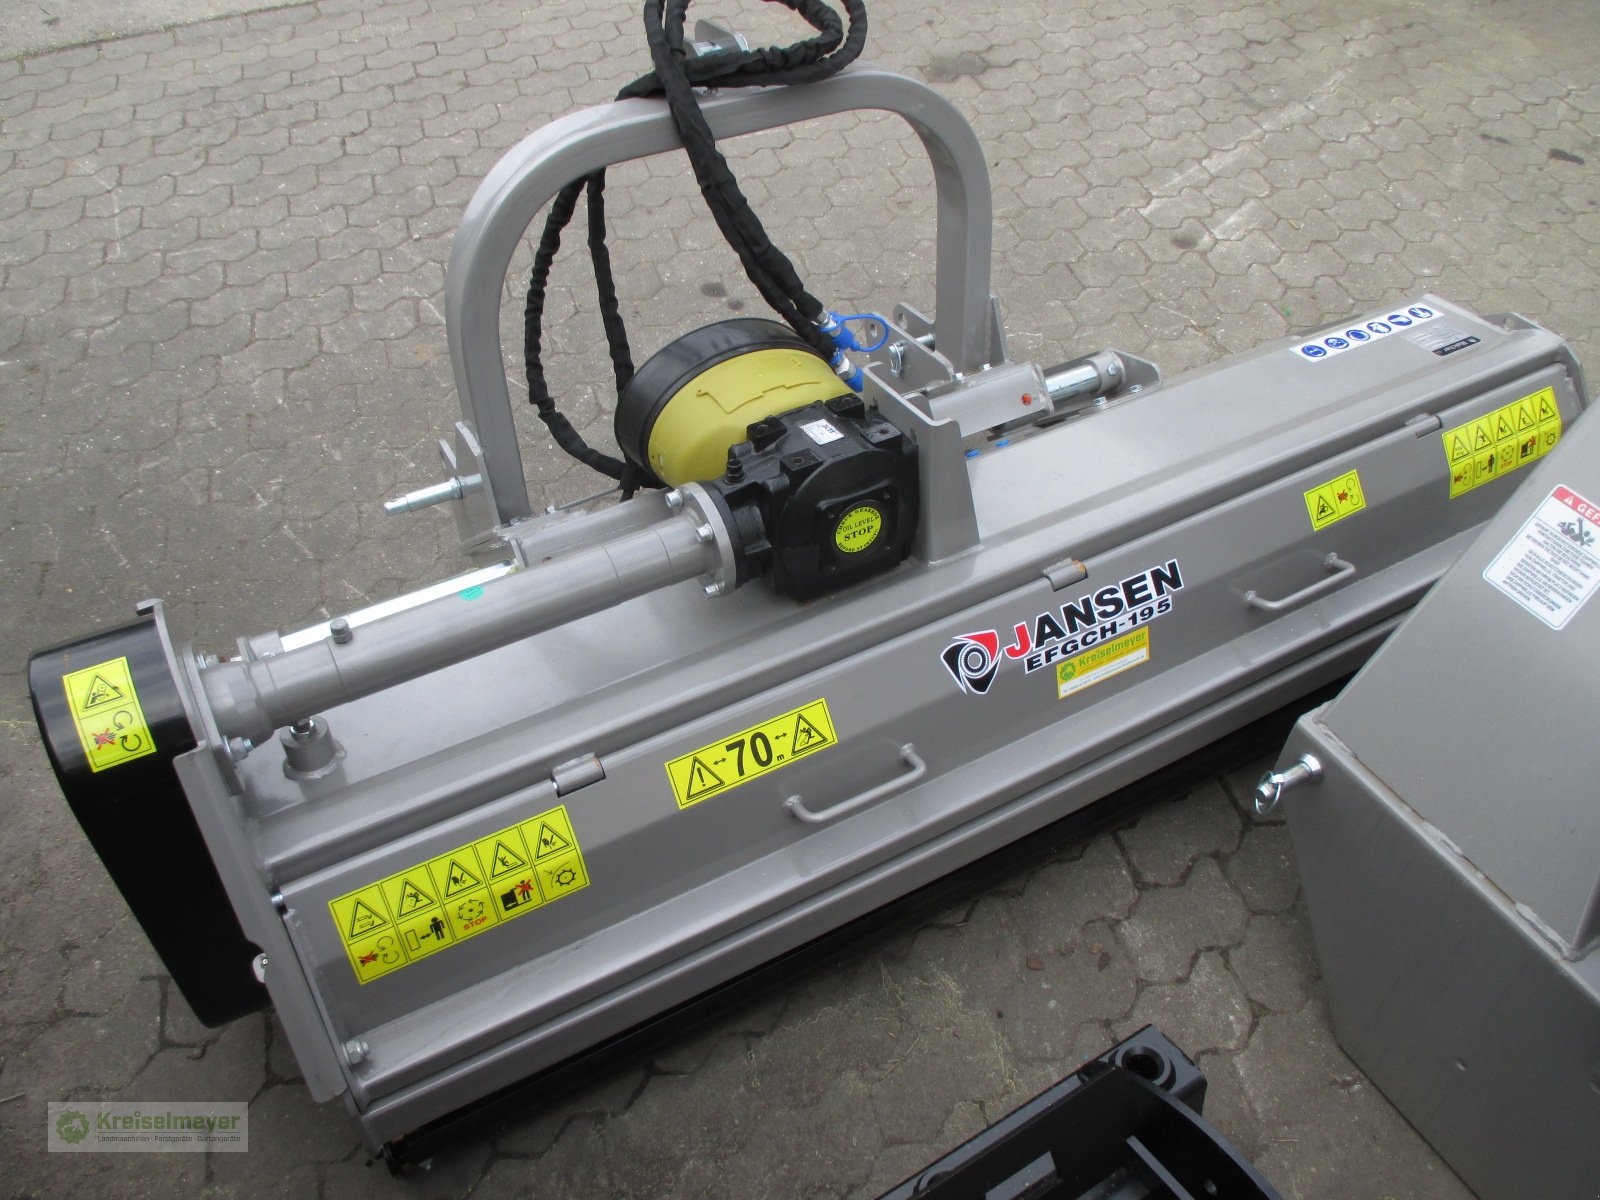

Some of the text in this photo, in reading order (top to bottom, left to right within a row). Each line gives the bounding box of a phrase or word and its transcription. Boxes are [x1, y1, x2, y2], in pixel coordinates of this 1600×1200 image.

[842, 517, 875, 532] OIL LEVEL
[844, 525, 874, 542] STOP
[1004, 560, 1182, 659] JANSEN
[1026, 597, 1171, 672] EFGCH-195
[1079, 631, 1147, 667] Kreiselmeyer
[725, 731, 785, 777] 70 m
[463, 916, 487, 930] STOP
